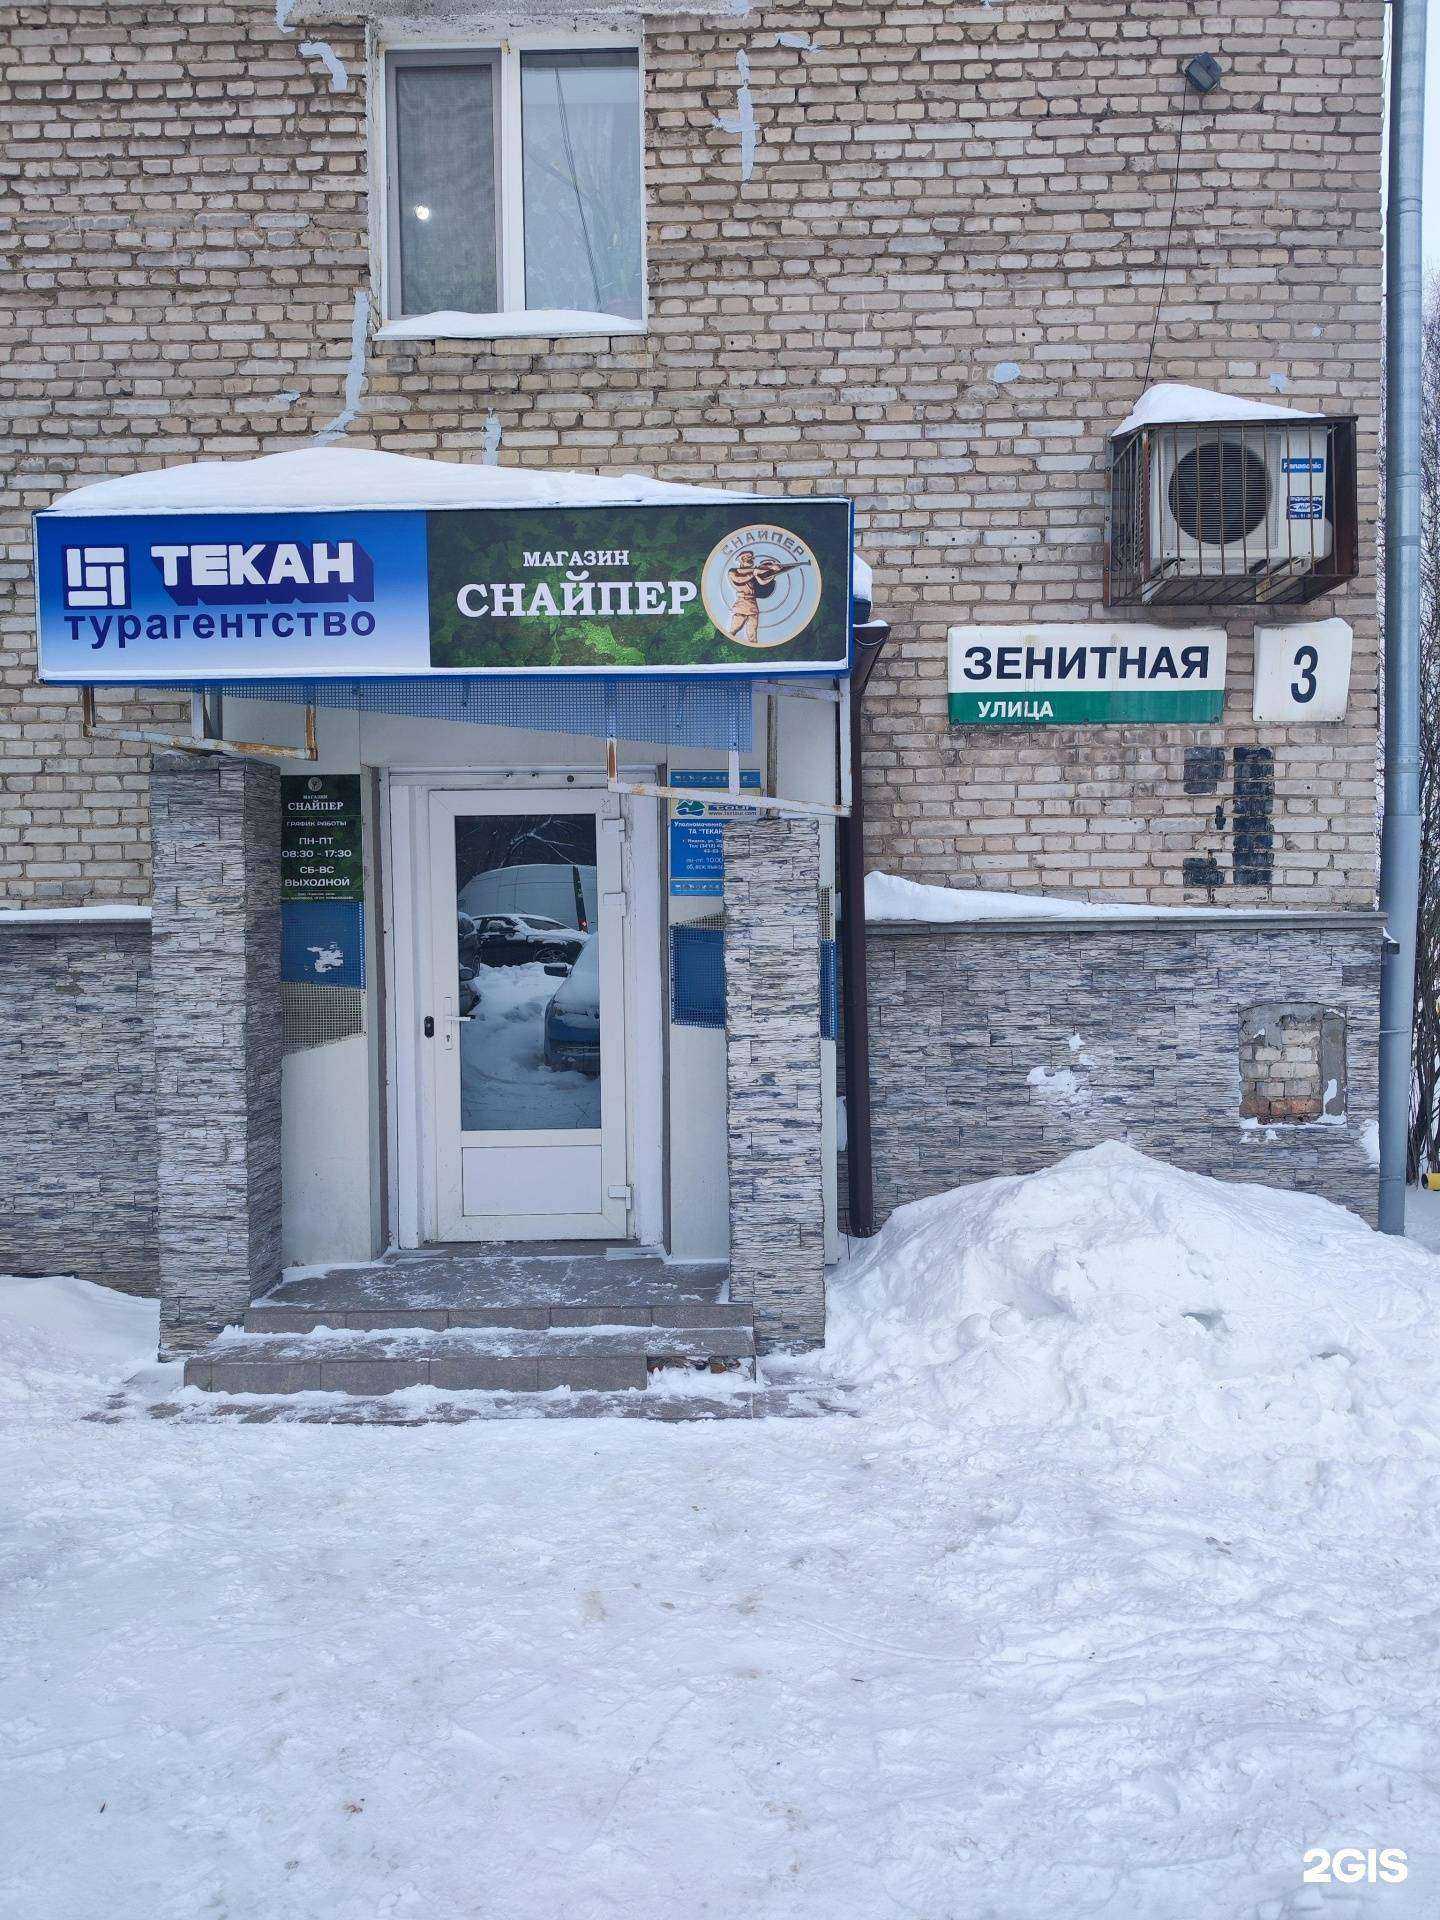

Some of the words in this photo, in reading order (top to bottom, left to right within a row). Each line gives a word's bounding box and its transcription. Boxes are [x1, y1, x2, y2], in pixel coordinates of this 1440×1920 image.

[150, 541, 355, 587] ТЕКАН
[522, 549, 630, 568] МАГАЗИН
[455, 569, 699, 618] СНАЙПЕР
[63, 610, 377, 649] турагентство
[963, 645, 1210, 681] ЗЕНИТНАЯ
[1289, 645, 1320, 704] 3
[976, 699, 1055, 721] УЛИЦА
[287, 799, 345, 811] СНАЙПЕР
[298, 837, 334, 845] ПН-ПТ
[281, 850, 314, 858] 08:30
[324, 849, 352, 858] 17:30
[299, 866, 335, 874] СБ-ВС
[284, 876, 350, 887] ВЫХОДНОЙ
